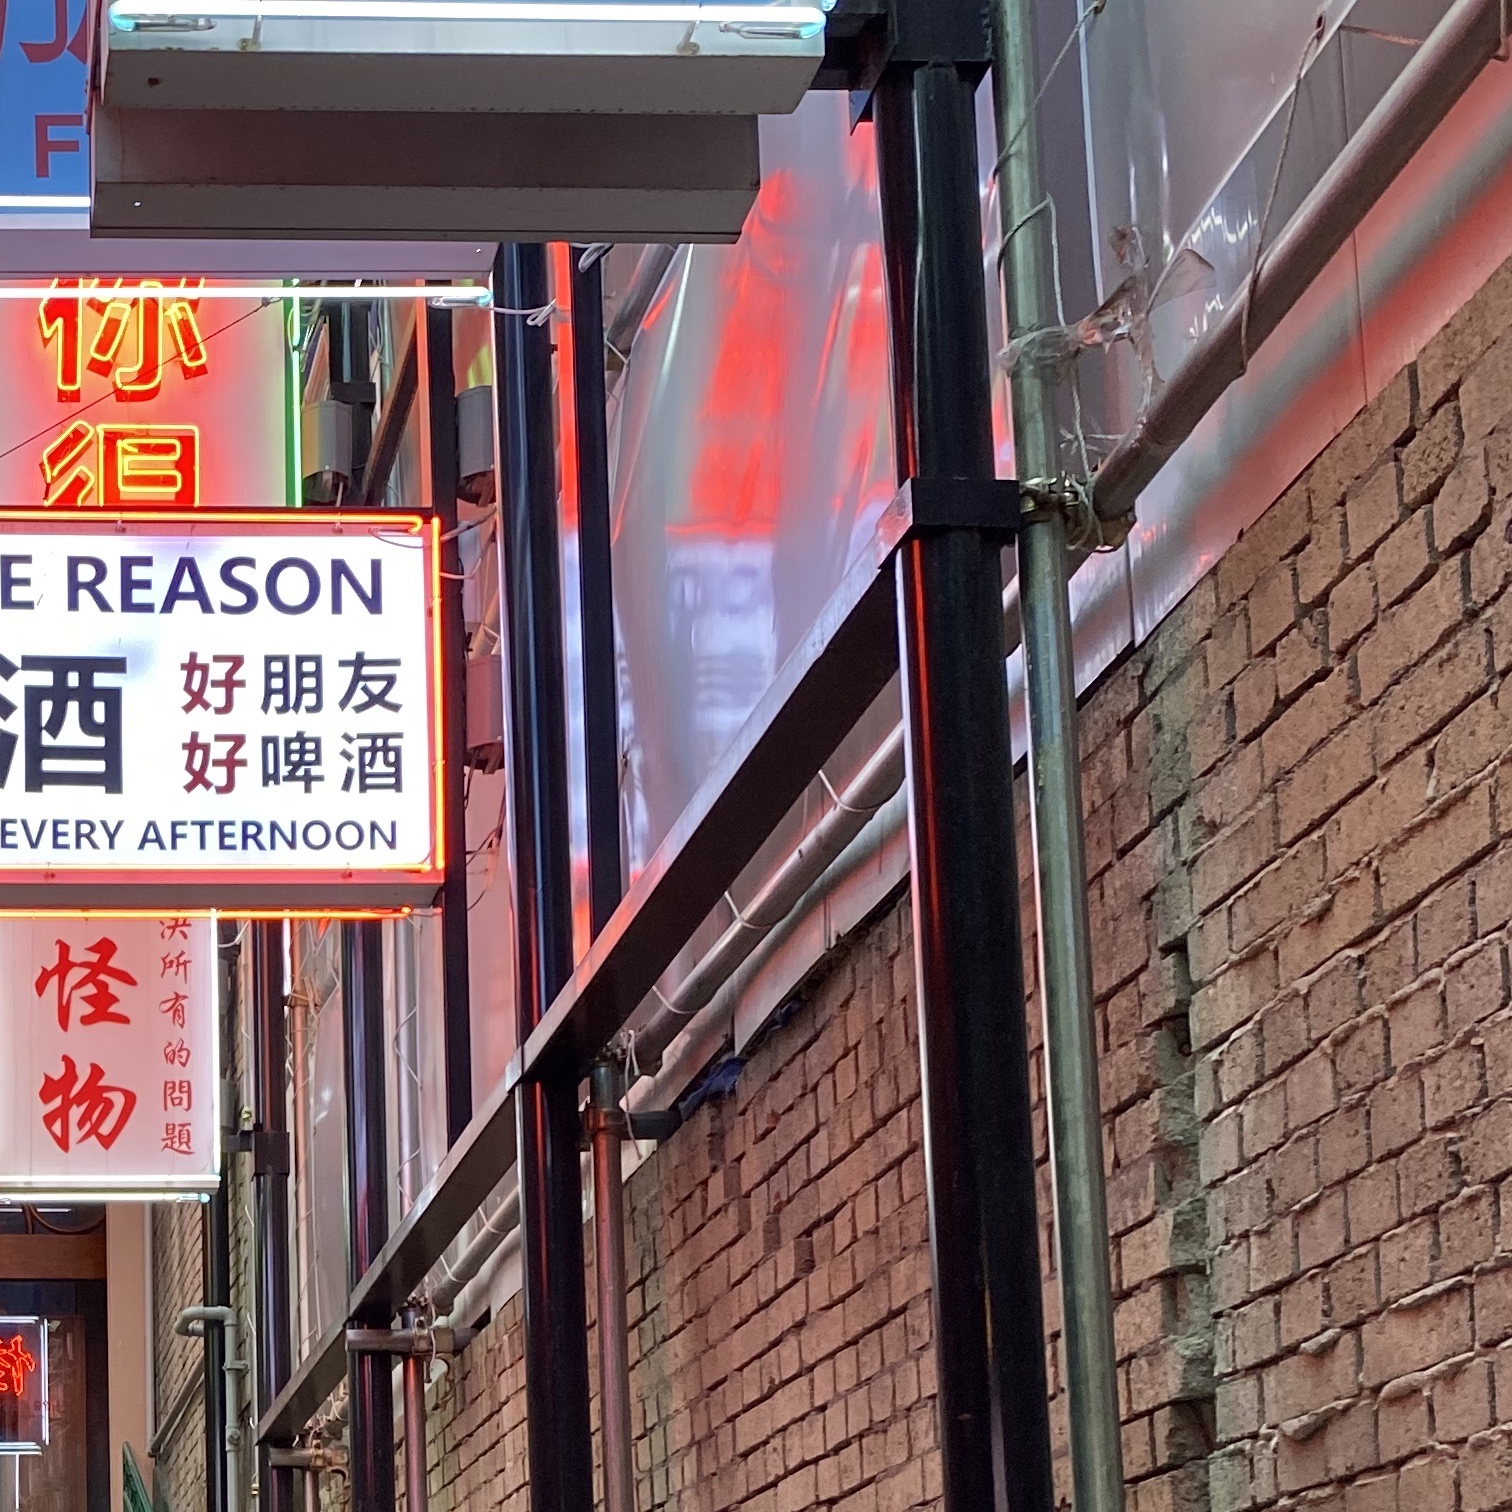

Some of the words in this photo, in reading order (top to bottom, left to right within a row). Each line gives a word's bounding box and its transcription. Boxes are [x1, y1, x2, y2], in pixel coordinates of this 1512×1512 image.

[67, 556, 383, 615] REASON
[180, 651, 404, 715] 好朋友
[181, 730, 405, 795] 好啤酒
[0, 818, 125, 850] EVERY
[137, 819, 397, 851] AFTERNOON
[35, 936, 138, 1154] 怪物
